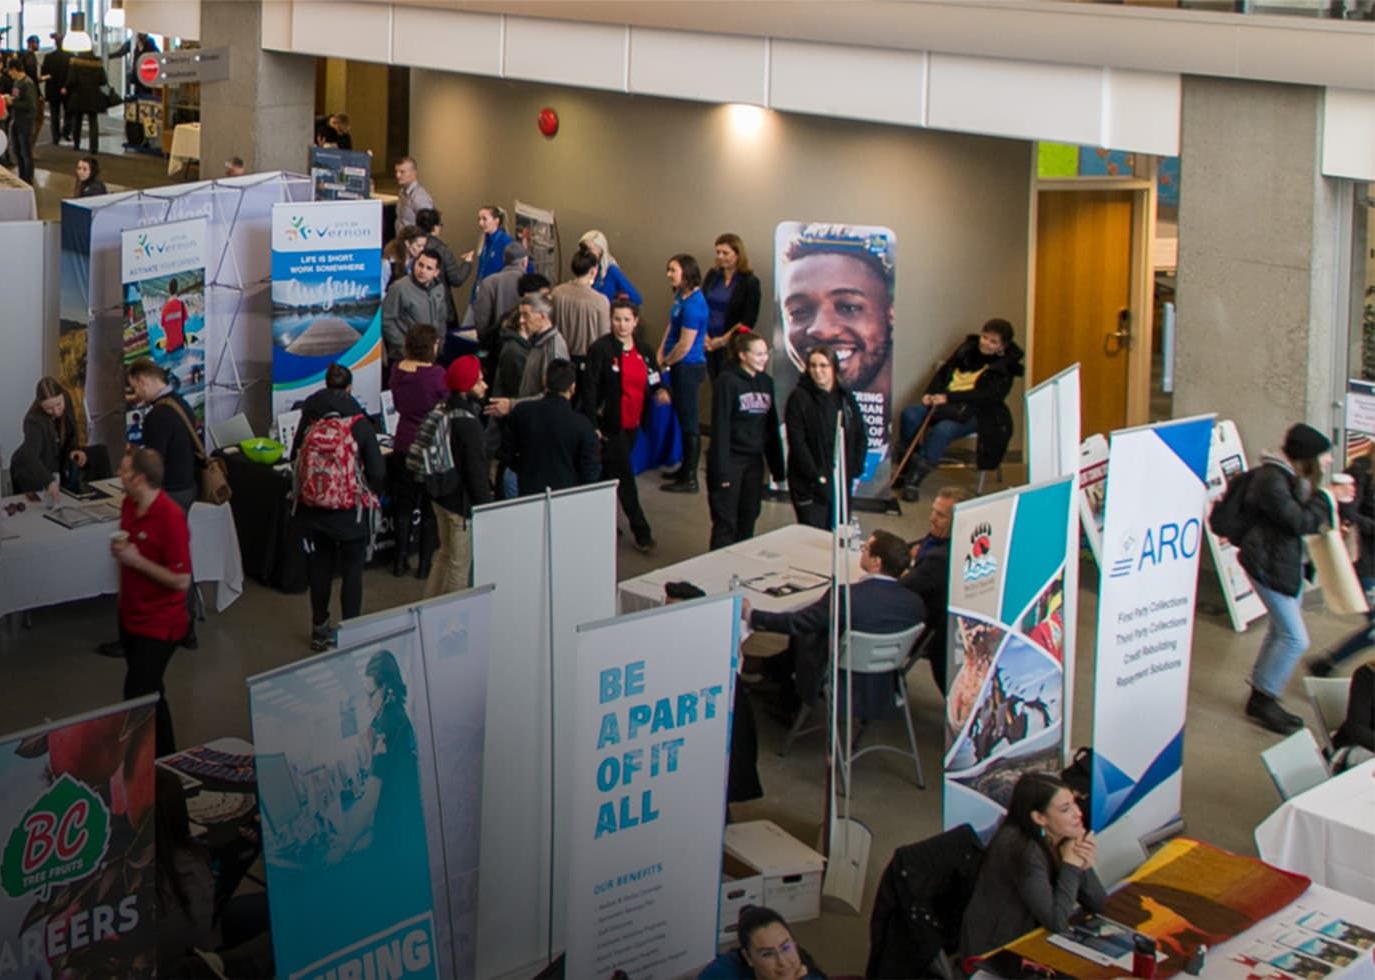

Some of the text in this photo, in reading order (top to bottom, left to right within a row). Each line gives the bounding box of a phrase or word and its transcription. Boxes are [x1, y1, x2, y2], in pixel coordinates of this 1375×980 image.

[289, 265, 314, 274] WORK
[300, 255, 317, 264] LIFE
[1137, 517, 1202, 571] ARO
[599, 660, 646, 705] BE
[597, 685, 723, 751] A PART
[596, 737, 686, 794] OF IT
[22, 799, 89, 874] BC
[594, 789, 660, 840] ALL
[22, 859, 85, 889] TREE FRUITS
[593, 862, 663, 896] OUR BENEFITS
